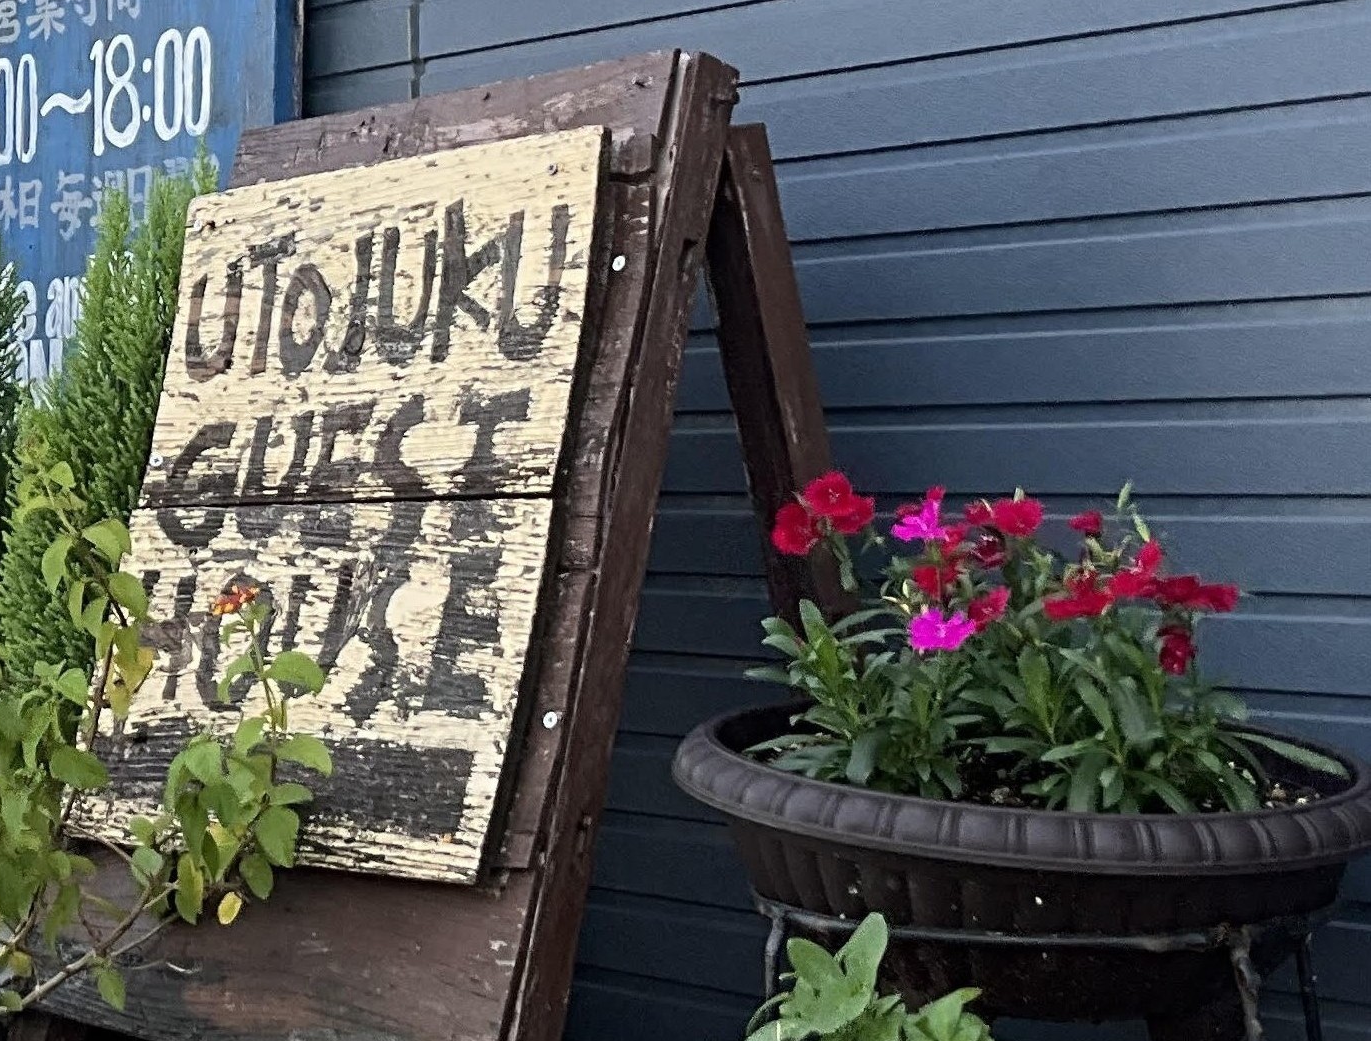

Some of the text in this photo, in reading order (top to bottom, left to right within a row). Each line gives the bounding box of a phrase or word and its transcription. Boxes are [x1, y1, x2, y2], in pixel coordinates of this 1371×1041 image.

[184, 199, 570, 382] UTOJUKU
[155, 387, 531, 549] GUEST
[139, 554, 503, 726] HOUSE
